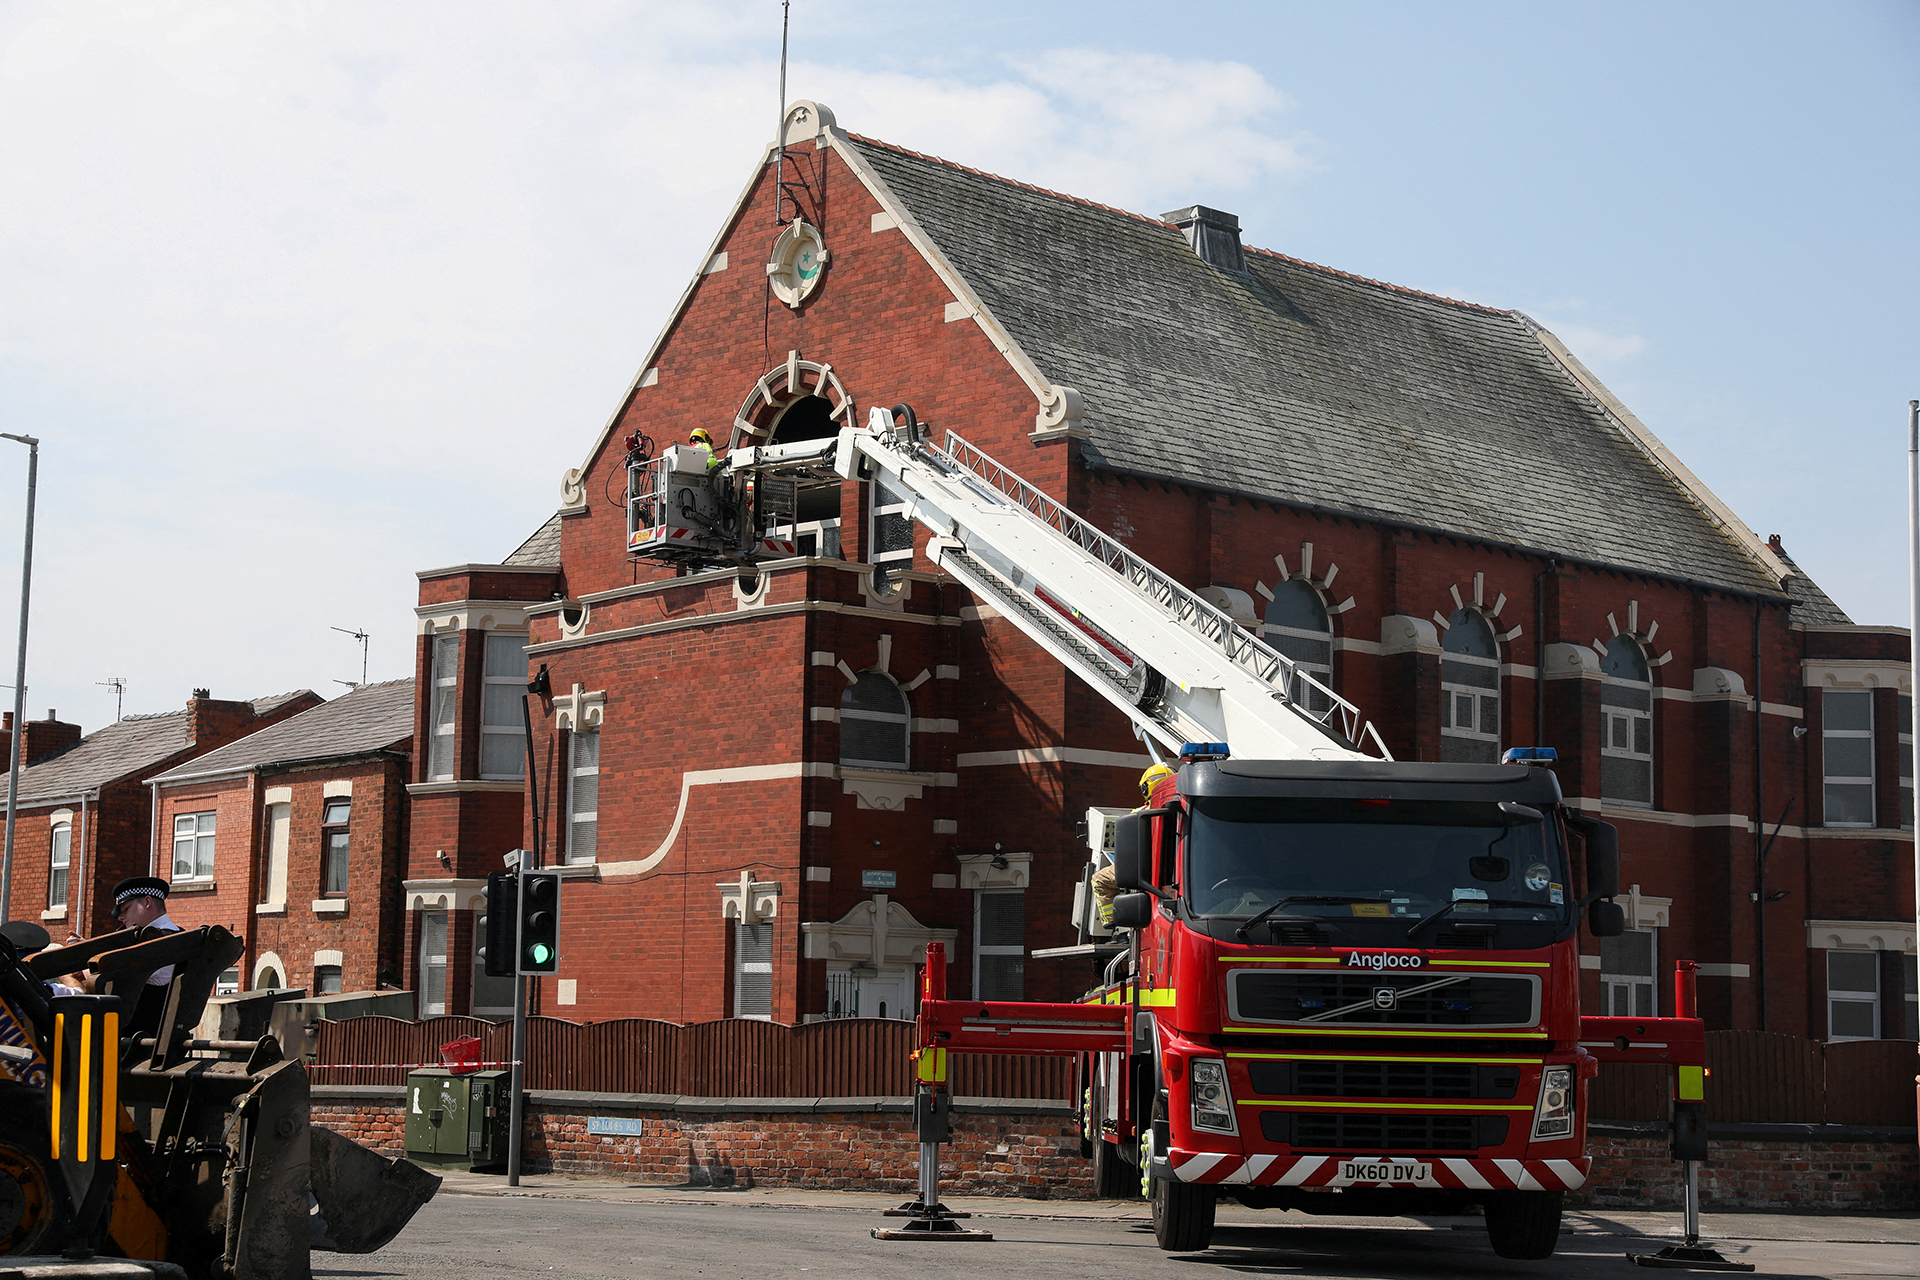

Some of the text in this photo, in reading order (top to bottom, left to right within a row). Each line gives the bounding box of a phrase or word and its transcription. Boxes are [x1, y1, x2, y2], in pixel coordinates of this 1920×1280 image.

[1347, 951, 1422, 971] Angloco
[626, 1122, 638, 1132] RD
[1345, 1164, 1426, 1180] DK60 DVJ
